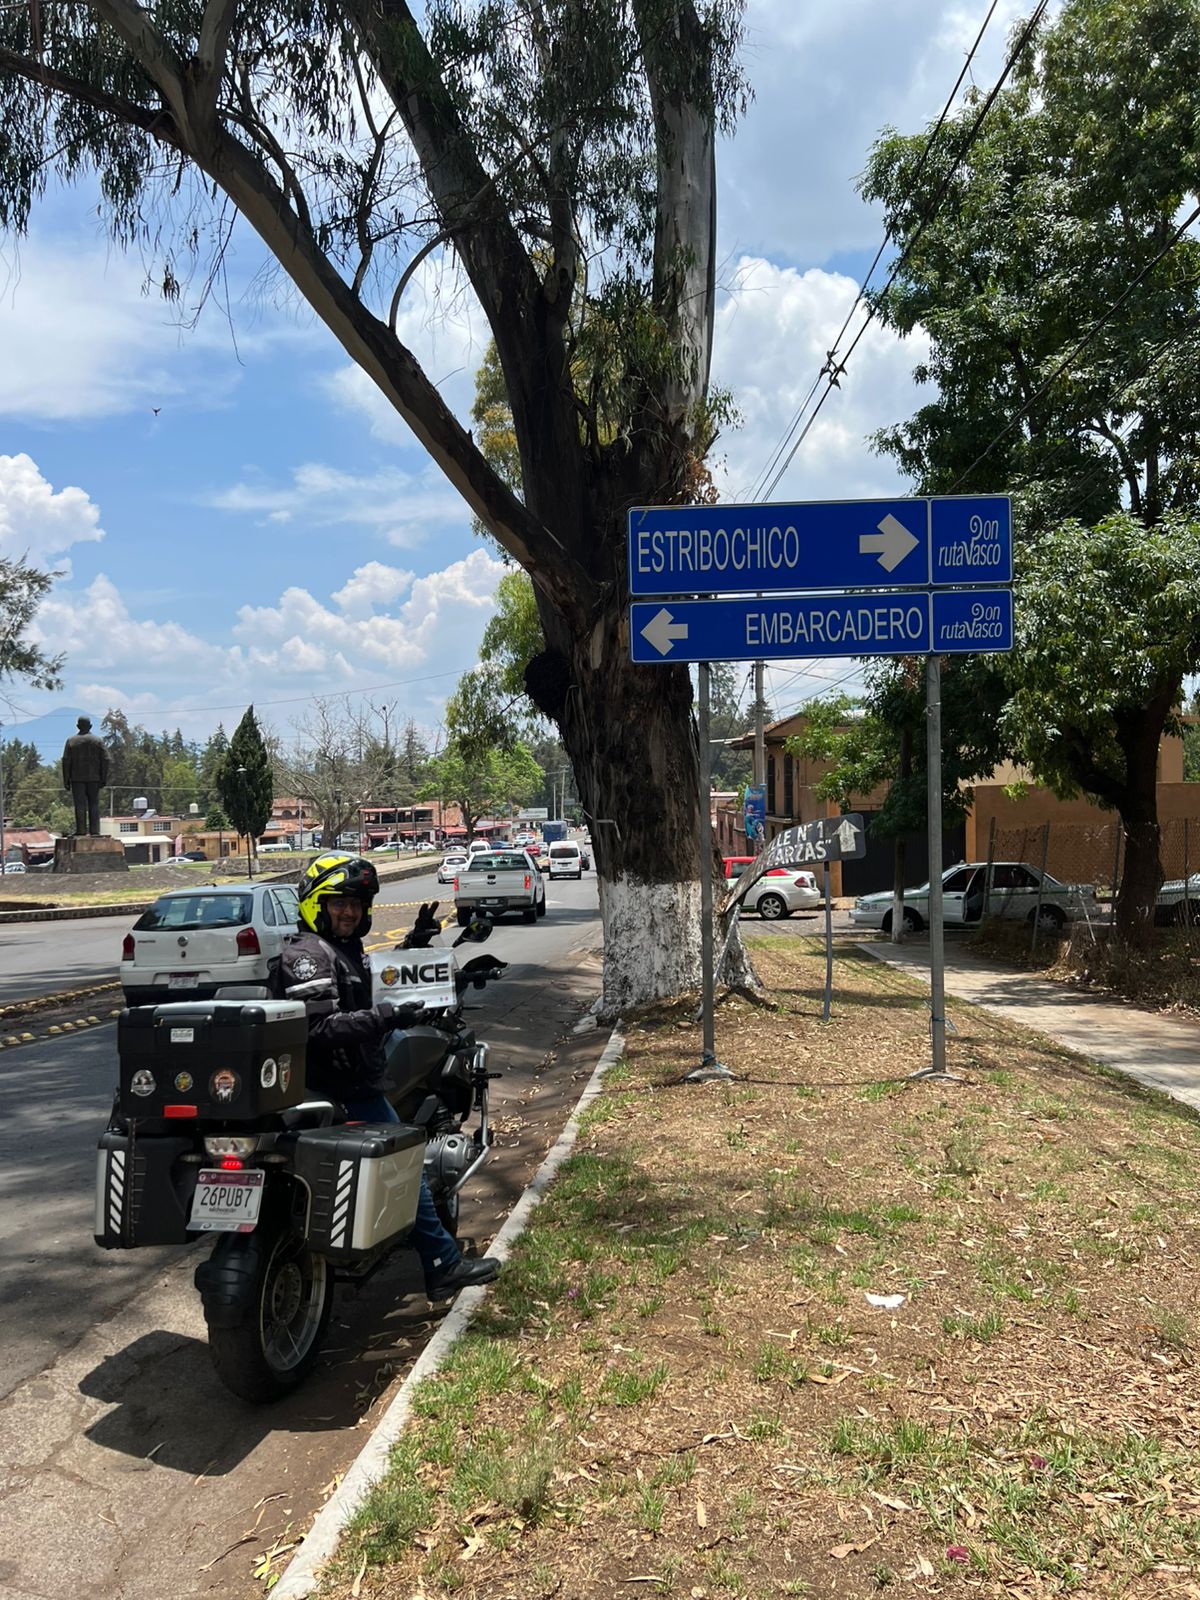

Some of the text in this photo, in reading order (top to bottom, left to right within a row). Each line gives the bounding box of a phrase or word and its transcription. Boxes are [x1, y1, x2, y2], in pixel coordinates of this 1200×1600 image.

[638, 526, 800, 573] ESTRIBOCHICO
[746, 607, 923, 645] EMBARCADERO
[200, 1186, 253, 1208] 26PUB7
